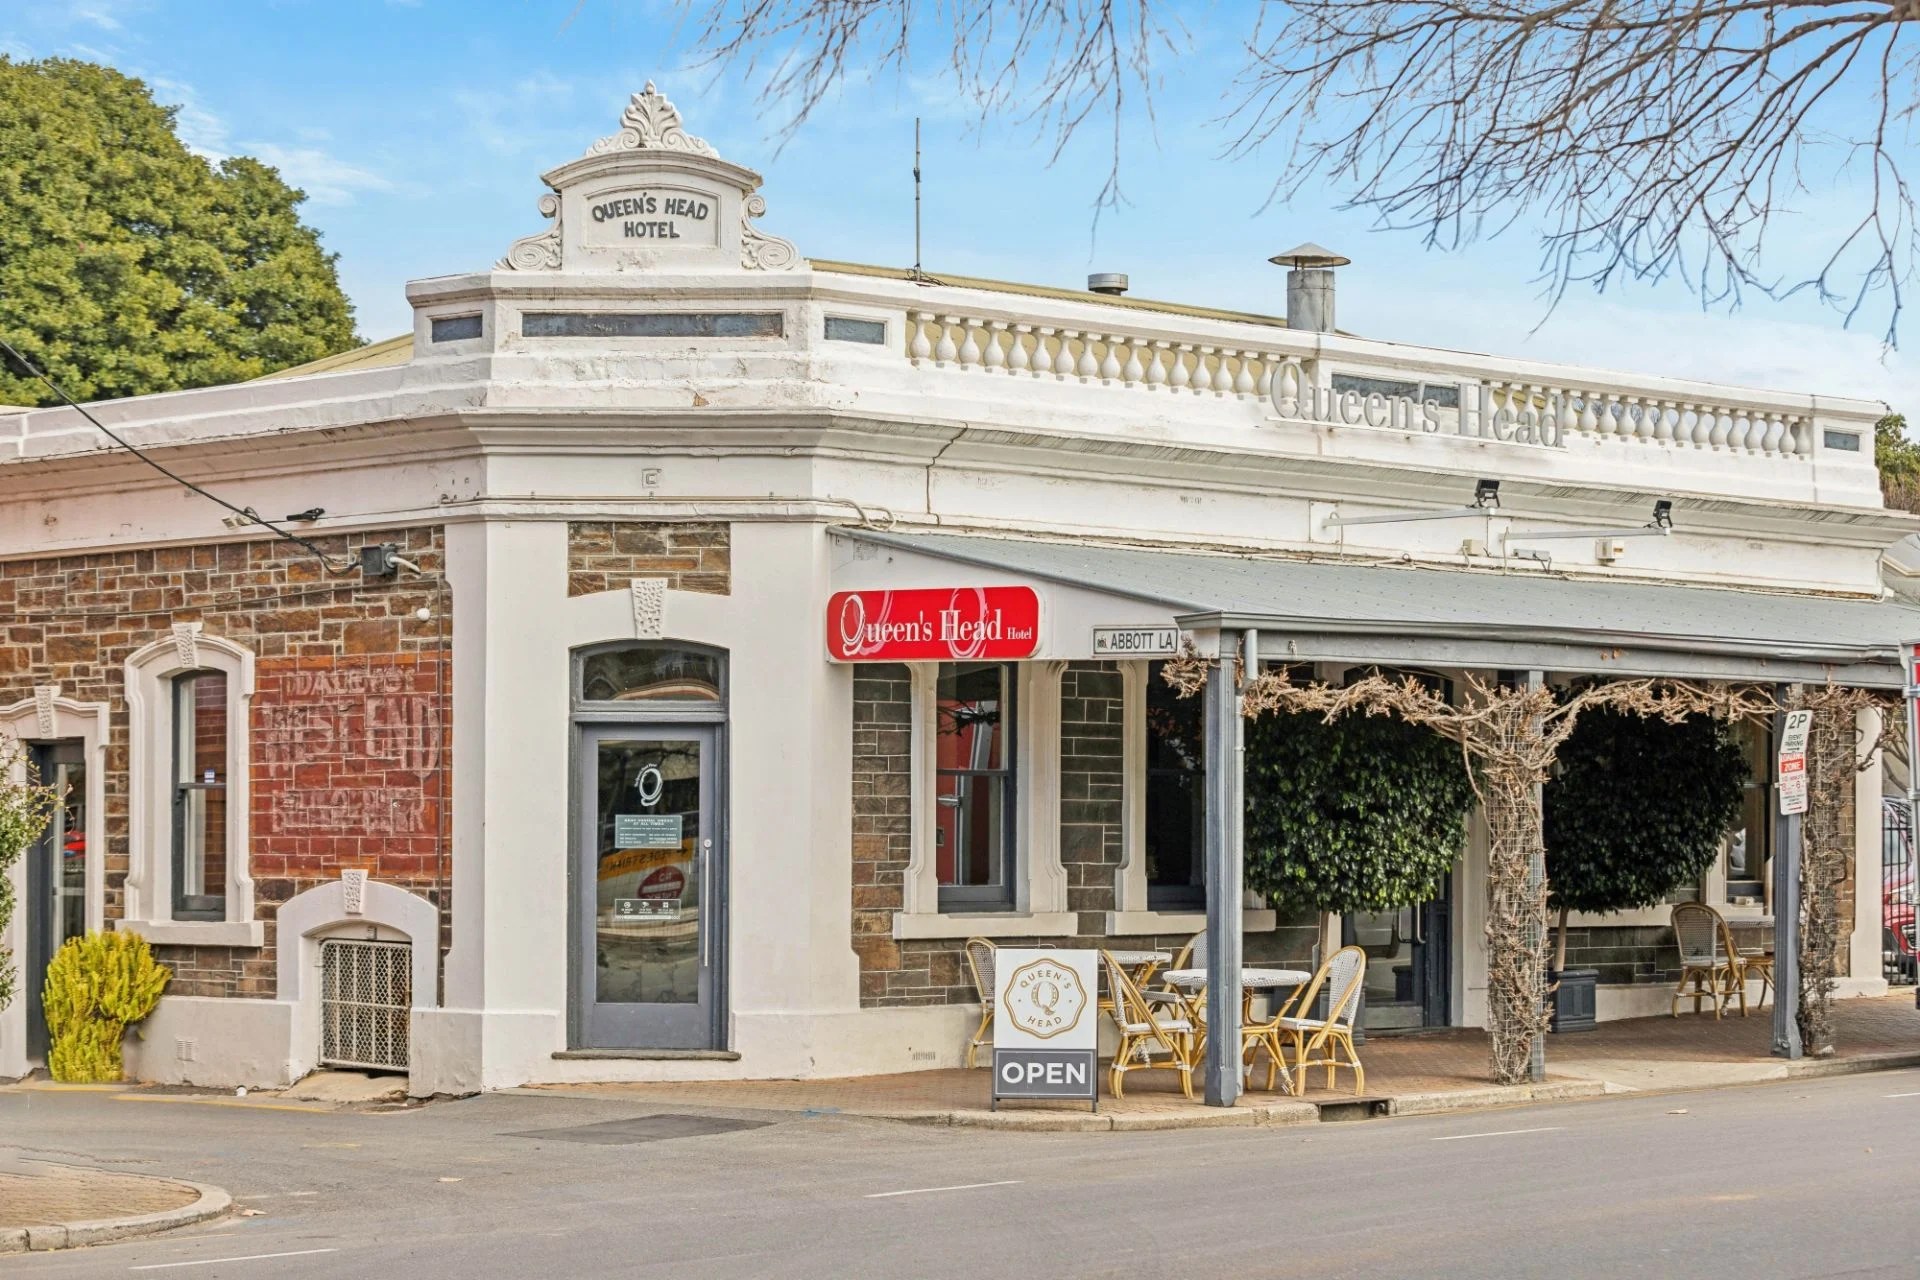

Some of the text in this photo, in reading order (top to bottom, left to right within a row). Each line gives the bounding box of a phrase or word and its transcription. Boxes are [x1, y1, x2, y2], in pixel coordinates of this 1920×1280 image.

[591, 192, 709, 222] QUEEN'S HEAD
[624, 221, 680, 238] HOTEL
[1270, 361, 1567, 448] Queen's Head
[841, 594, 1032, 656] Queen's Head Hotel
[1111, 632, 1173, 650] ABBOTT LA
[1788, 713, 1807, 729] 2P
[1020, 970, 1072, 989] QUEEN'S
[1027, 1016, 1063, 1027] HEAD
[1002, 1062, 1086, 1084] OPEN
